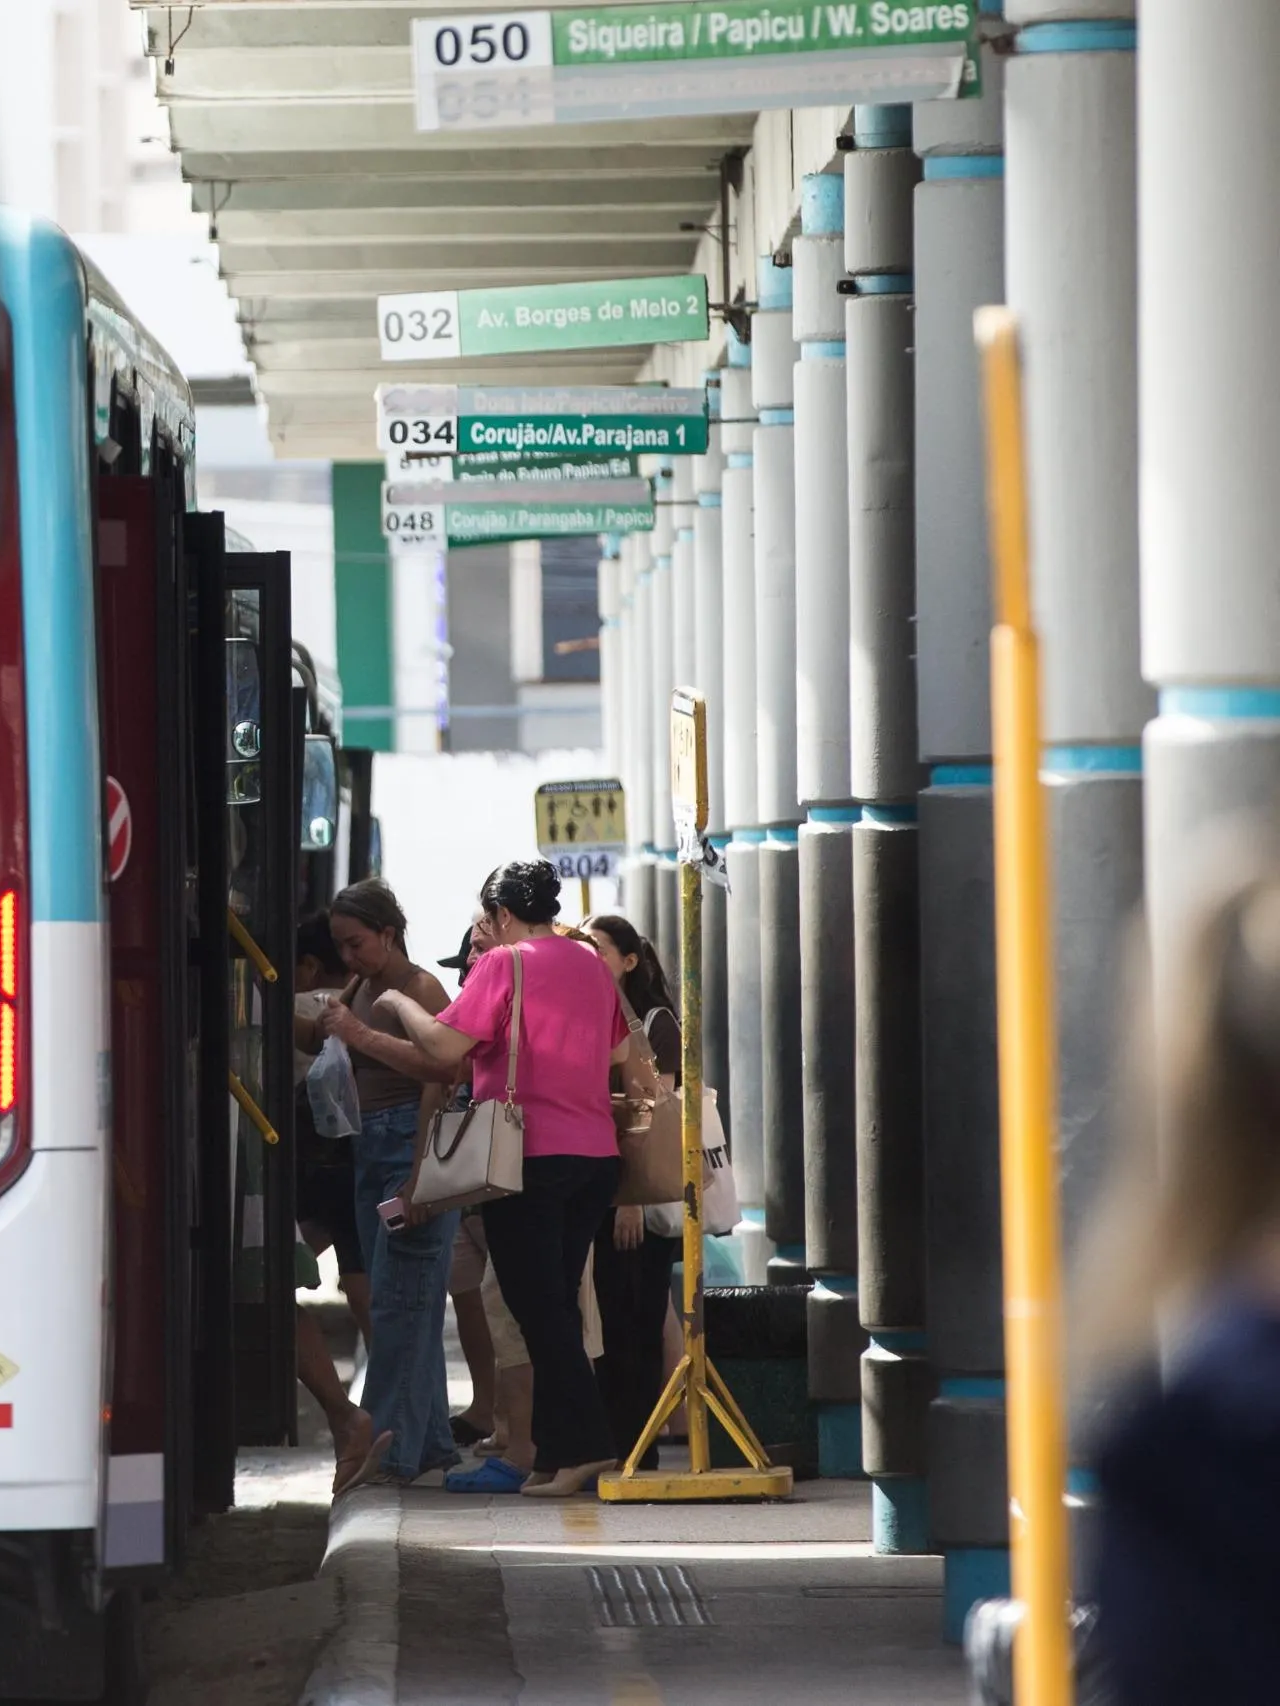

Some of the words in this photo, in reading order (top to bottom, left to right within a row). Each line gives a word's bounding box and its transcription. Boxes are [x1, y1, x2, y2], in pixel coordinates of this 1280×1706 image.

[434, 21, 530, 66] 050
[569, 15, 685, 57] Siqueira
[691, 13, 702, 46] /
[709, 9, 805, 50] Papicu
[811, 6, 821, 38] /
[826, 4, 864, 37] W.
[871, 2, 970, 36] Soares
[384, 308, 453, 342] 032
[477, 308, 509, 328] Av.
[515, 305, 591, 328] Borges
[598, 300, 624, 320] de
[630, 297, 681, 319] Melo
[686, 295, 699, 314] 2
[389, 419, 455, 445] 034
[470, 422, 669, 450] Corujão/Av.Parajana
[676, 424, 687, 446] 1
[386, 510, 434, 533] 048
[451, 510, 507, 534] Corujão
[518, 509, 594, 531] Parangaba
[605, 507, 654, 529] Papicu
